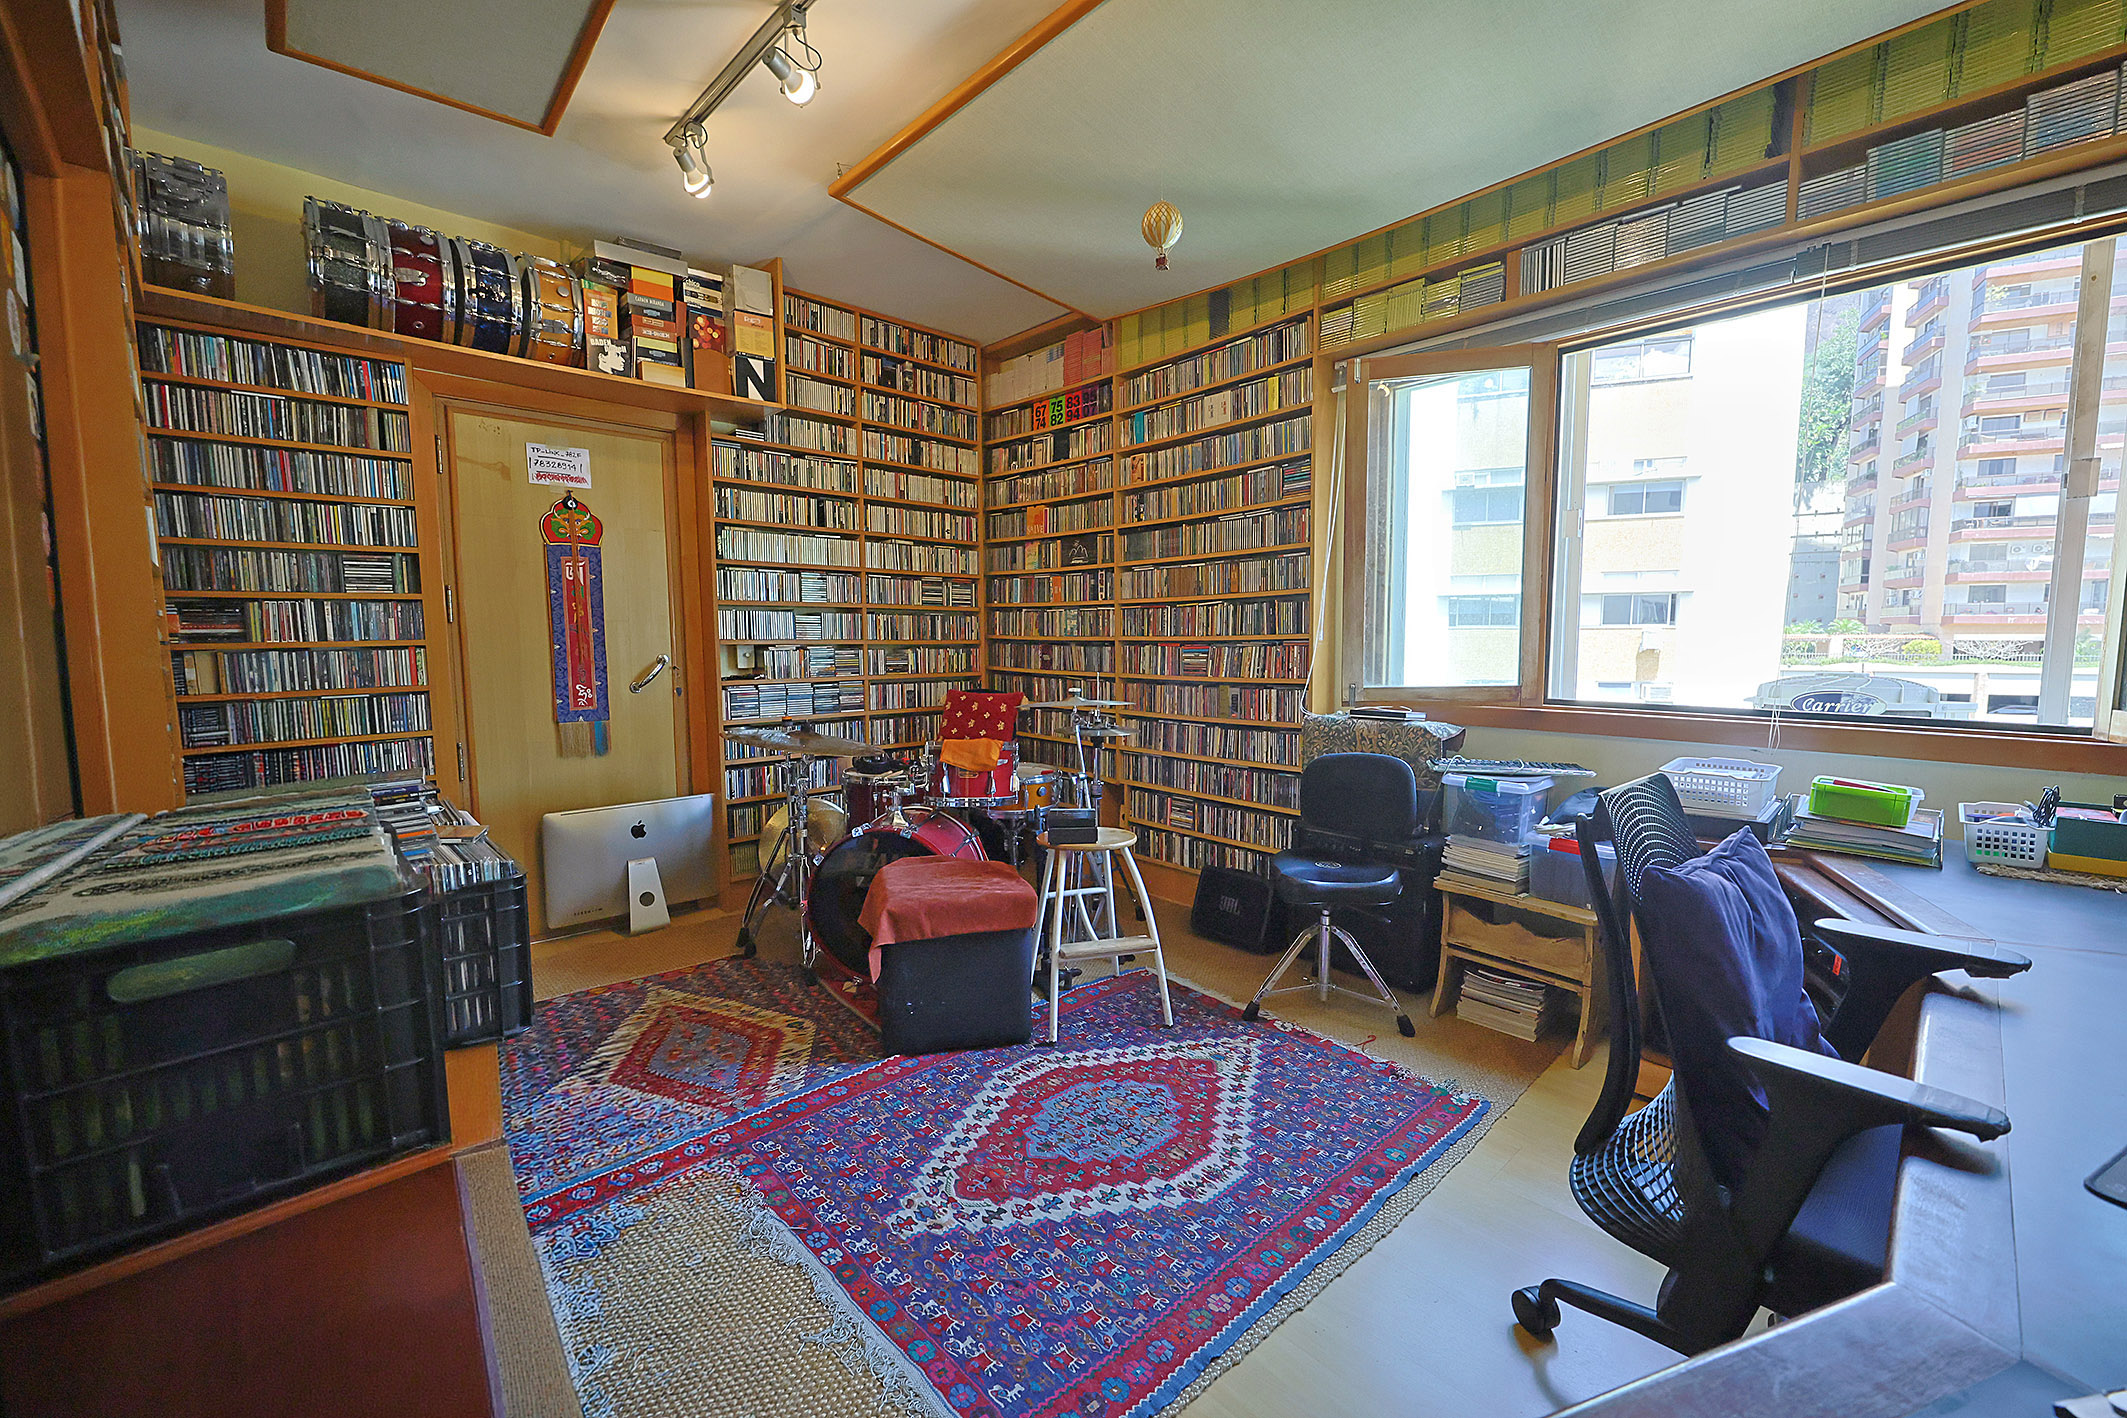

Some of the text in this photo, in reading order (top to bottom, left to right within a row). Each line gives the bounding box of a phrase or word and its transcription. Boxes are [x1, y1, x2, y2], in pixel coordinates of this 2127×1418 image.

[590, 337, 612, 347] BADEN
[1051, 400, 1063, 413] 75
[1066, 395, 1081, 409] 83
[1035, 405, 1047, 418] 67
[1066, 408, 1081, 422] 94
[1035, 417, 1047, 430] 74
[1050, 413, 1064, 426] 82
[1802, 697, 1875, 714] Carrier
[1219, 895, 1241, 915] JBL
